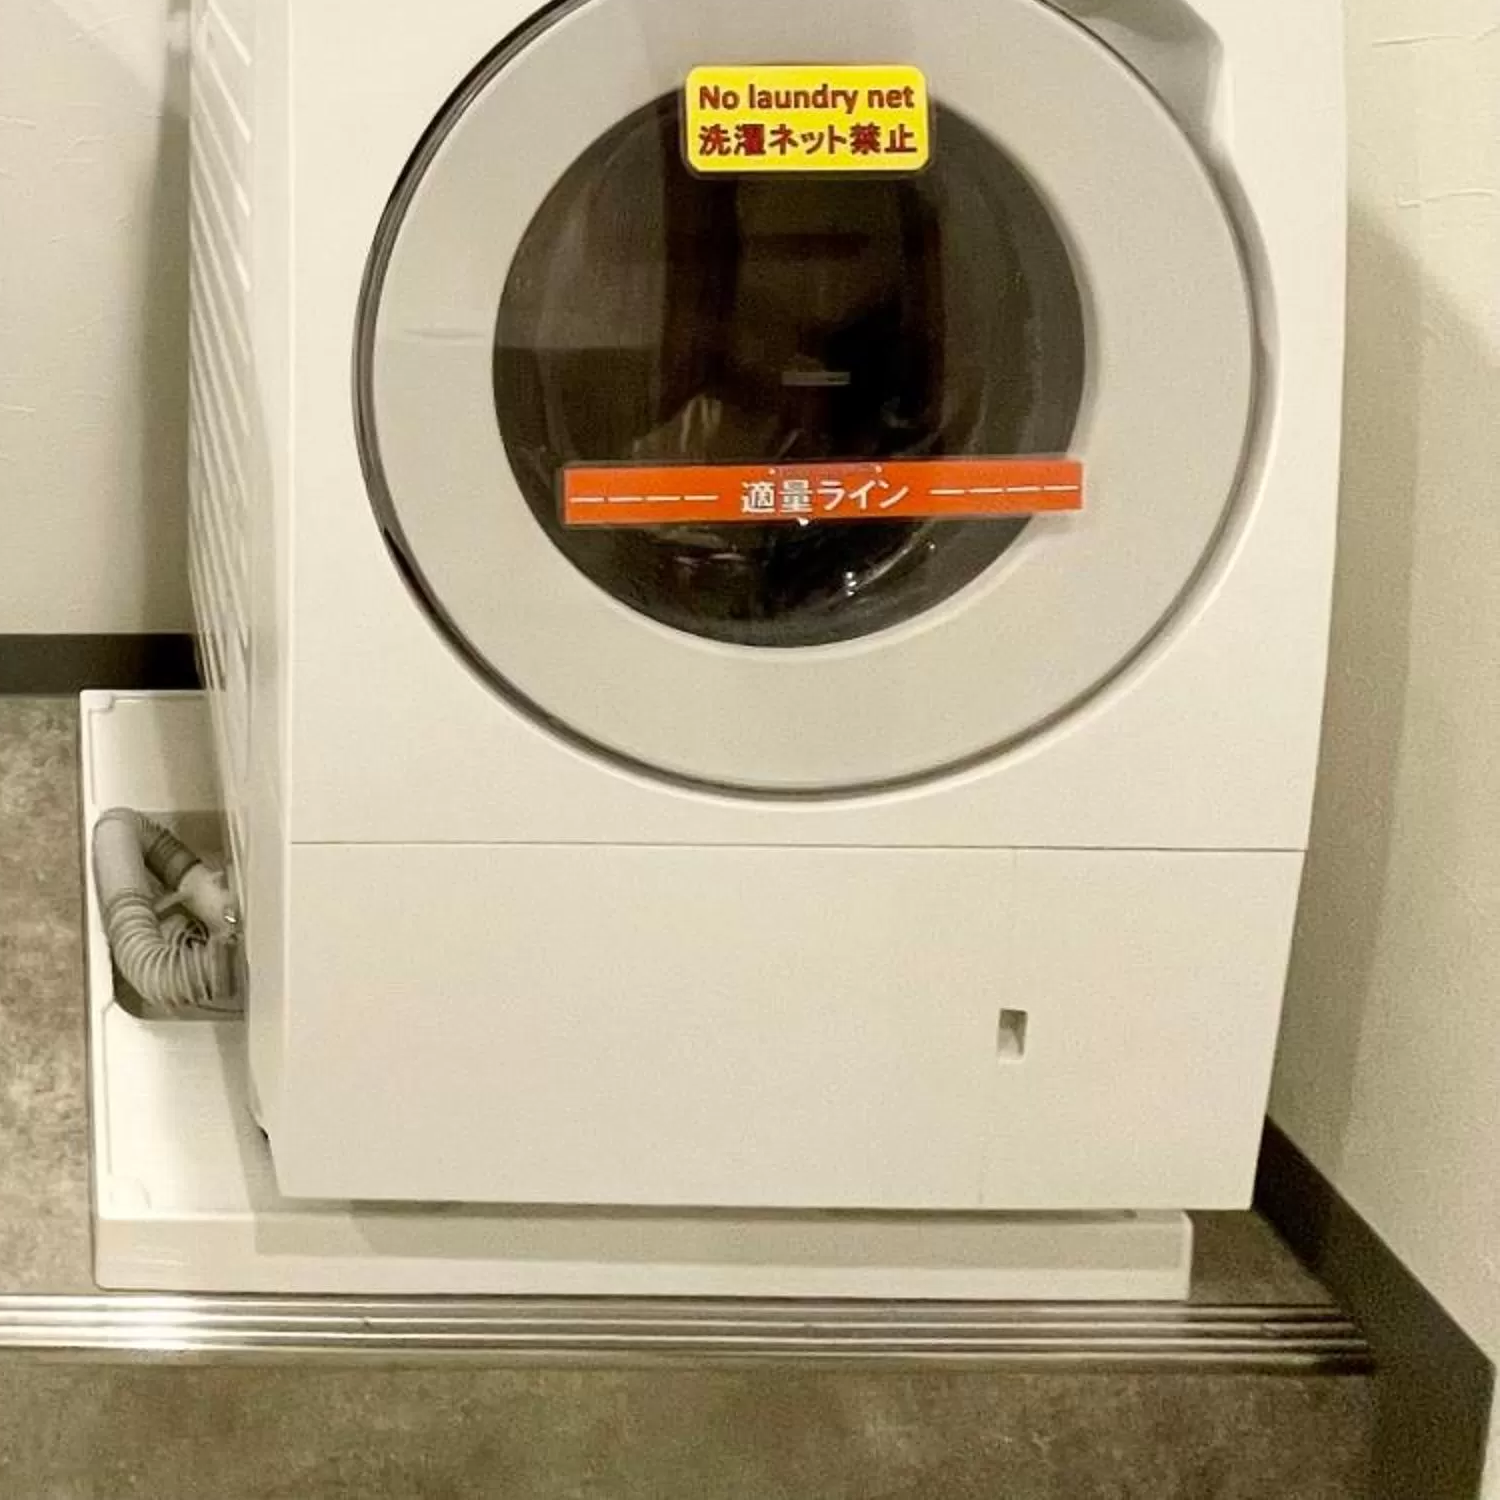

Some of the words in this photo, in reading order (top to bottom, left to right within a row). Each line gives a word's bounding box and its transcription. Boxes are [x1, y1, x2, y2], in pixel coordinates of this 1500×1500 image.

[699, 85, 740, 110] No
[749, 83, 859, 115] laundry
[867, 86, 915, 109] net
[699, 123, 918, 156] 洗濯ネット禁止
[741, 479, 910, 514] 適量ライン
